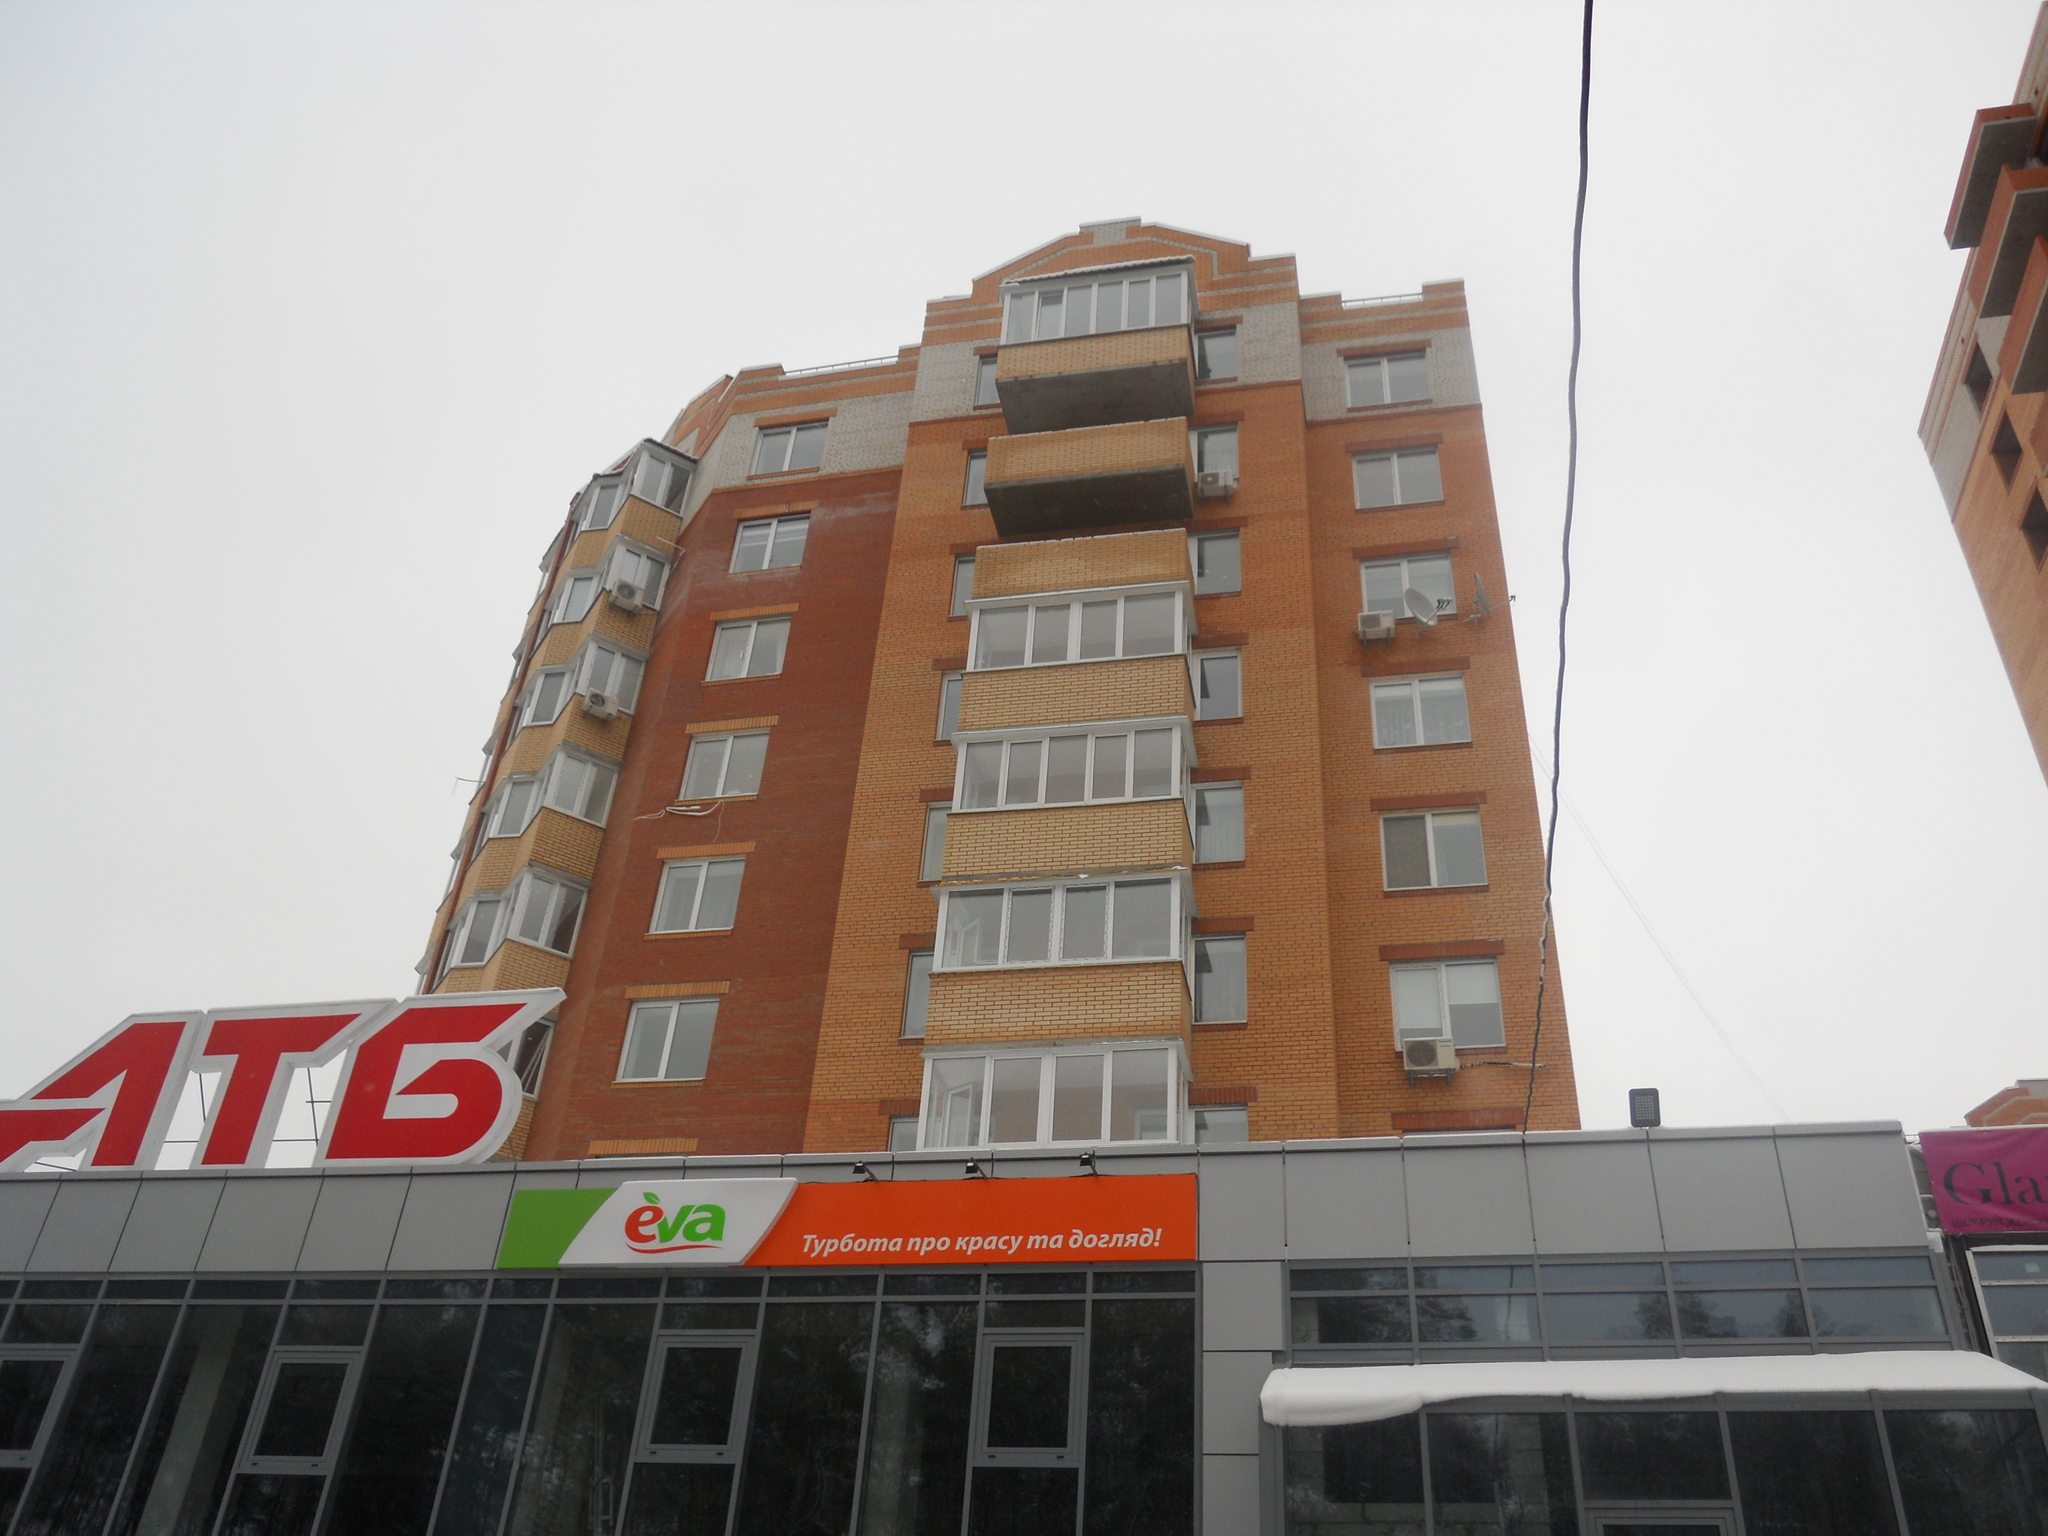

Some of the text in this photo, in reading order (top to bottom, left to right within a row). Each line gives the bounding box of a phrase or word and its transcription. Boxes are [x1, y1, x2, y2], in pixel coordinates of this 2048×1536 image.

[0, 1001, 530, 1168] АТБ
[1943, 1161, 2048, 1206] Gla
[802, 1227, 1163, 1258] Турбота про красу та догляд!
